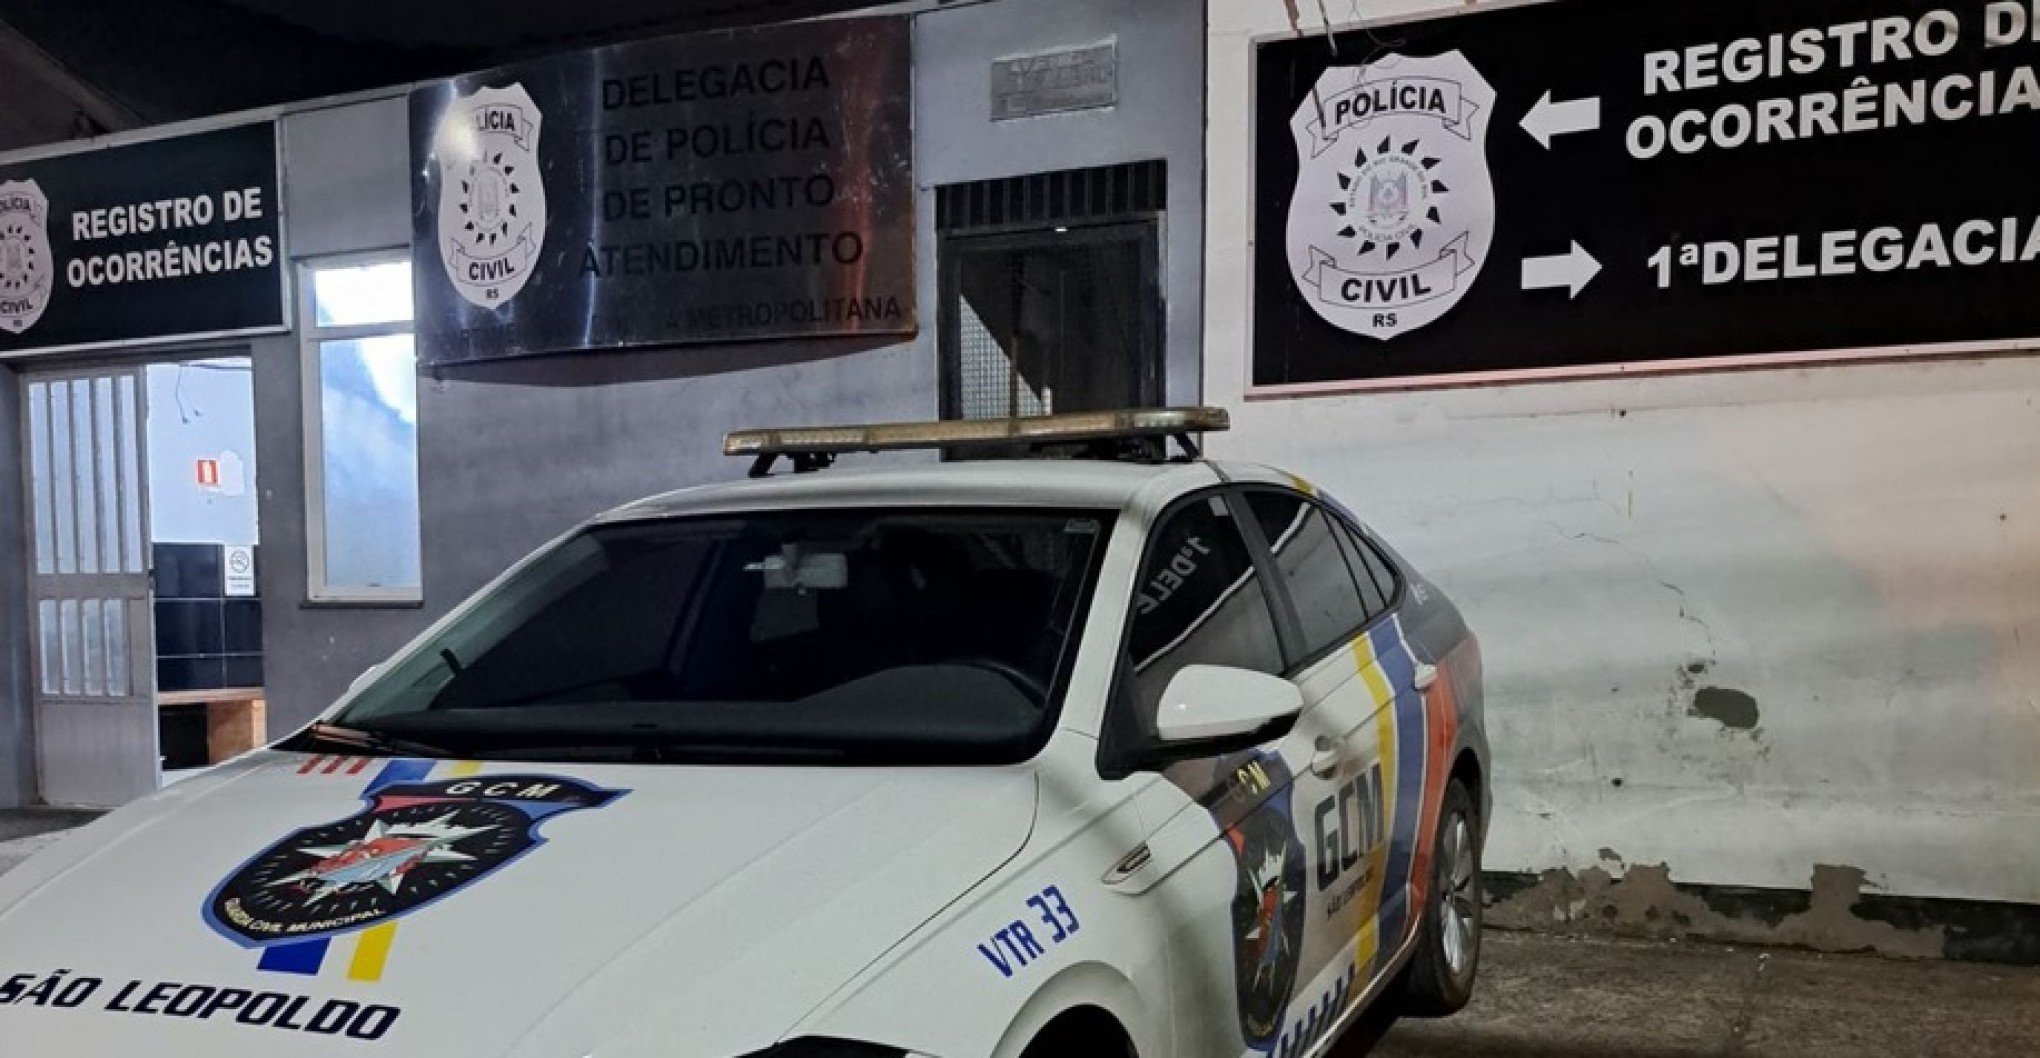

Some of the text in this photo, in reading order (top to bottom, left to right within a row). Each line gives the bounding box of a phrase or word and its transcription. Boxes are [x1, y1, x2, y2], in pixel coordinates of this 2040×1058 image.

[1643, 0, 2040, 96] REGISTRO D
[602, 54, 830, 111] DELEGACIA
[1336, 80, 1446, 125] POLÍCIA
[605, 110, 830, 165] DE POLÍCIA
[72, 187, 263, 241] REGISTRO DE
[604, 173, 835, 221] DE PRONTO
[67, 235, 273, 288] OCORRÊNCIAS
[468, 257, 515, 281] CIVIL
[578, 230, 864, 278] ATENDIMENTO
[1341, 272, 1431, 303] CIVIL
[1372, 312, 1398, 328] RS
[444, 780, 562, 799] GCM
[1315, 762, 1384, 892] GCM
[286, 908, 387, 933] MUNICIPAL
[977, 884, 1080, 978] VTR 33
[0, 968, 401, 1041] SÃO LEOPOLDO
